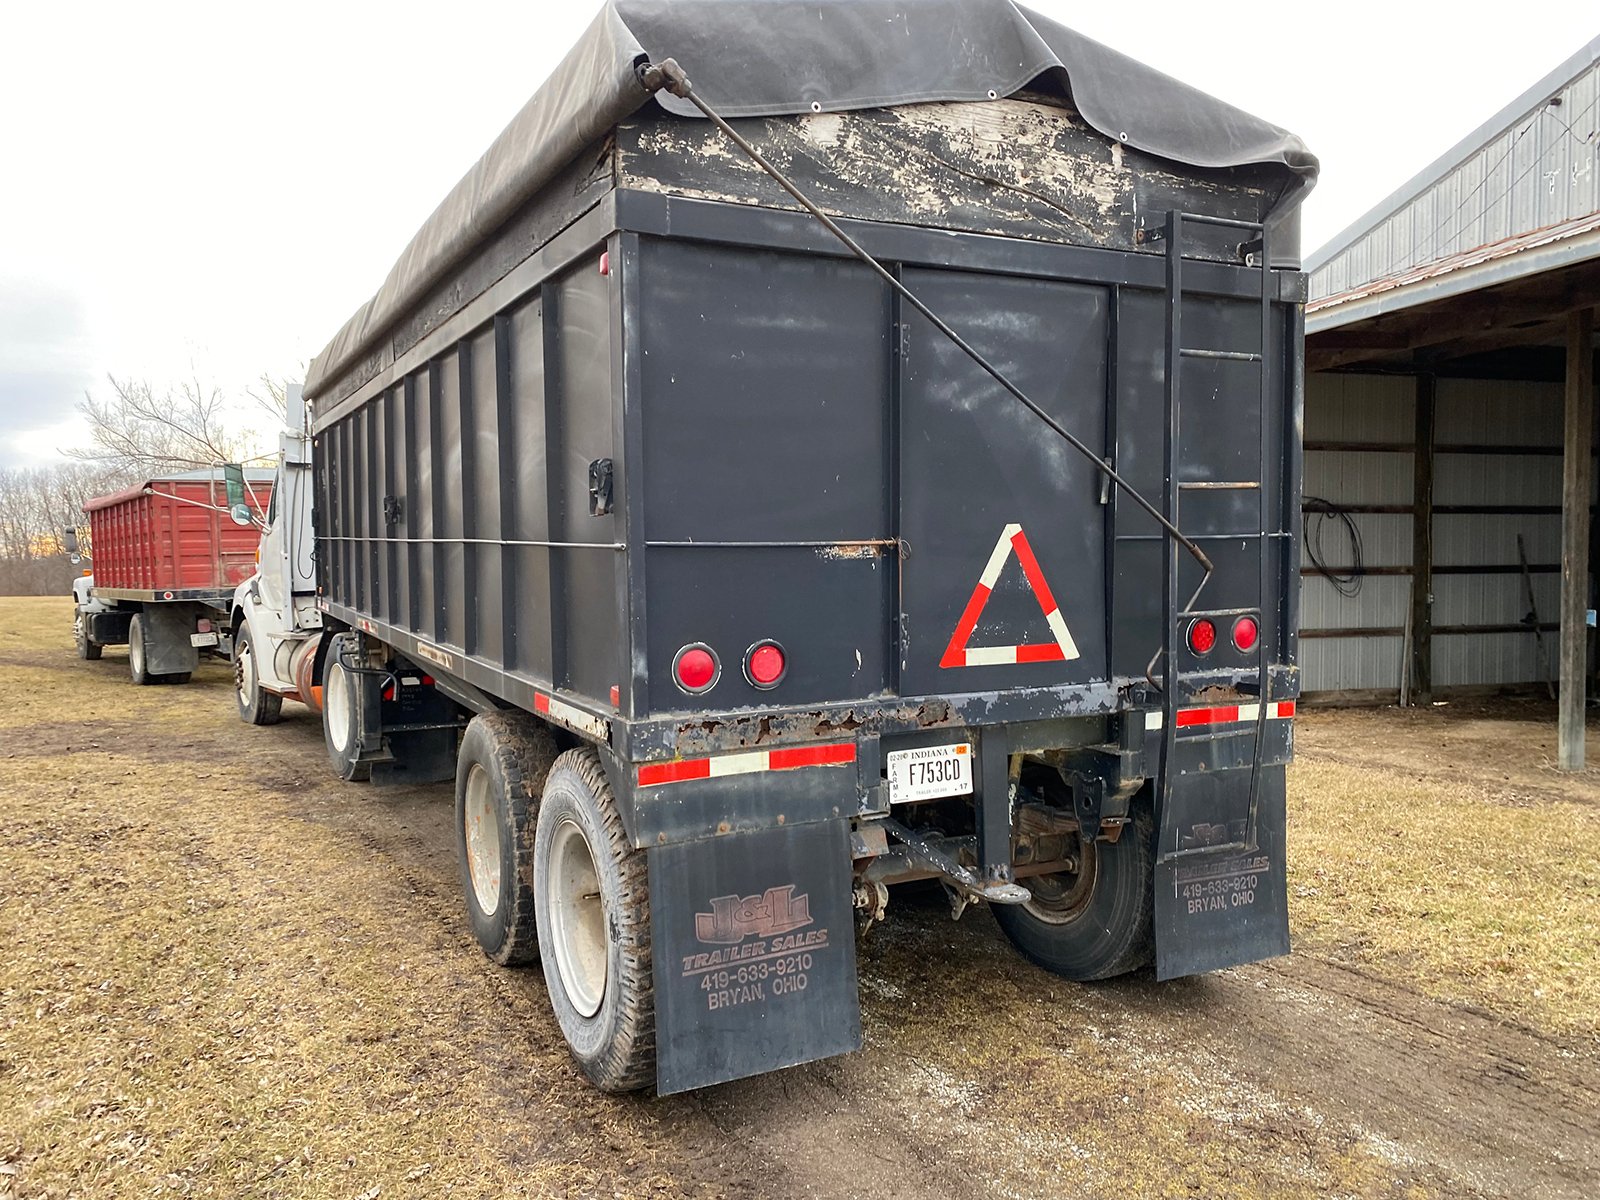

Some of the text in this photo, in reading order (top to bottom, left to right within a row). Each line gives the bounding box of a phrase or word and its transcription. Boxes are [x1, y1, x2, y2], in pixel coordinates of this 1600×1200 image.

[911, 748, 947, 759] INDIANA
[910, 758, 960, 786] F753CD
[1183, 875, 1258, 899] 419-633-9210
[1188, 890, 1255, 914] BRYAN, OHIO
[695, 884, 814, 944] J&L
[682, 929, 828, 970] TRAILER SALES
[701, 953, 813, 991] 419-633-9210
[708, 973, 808, 1011] BRYAN, OHIO
